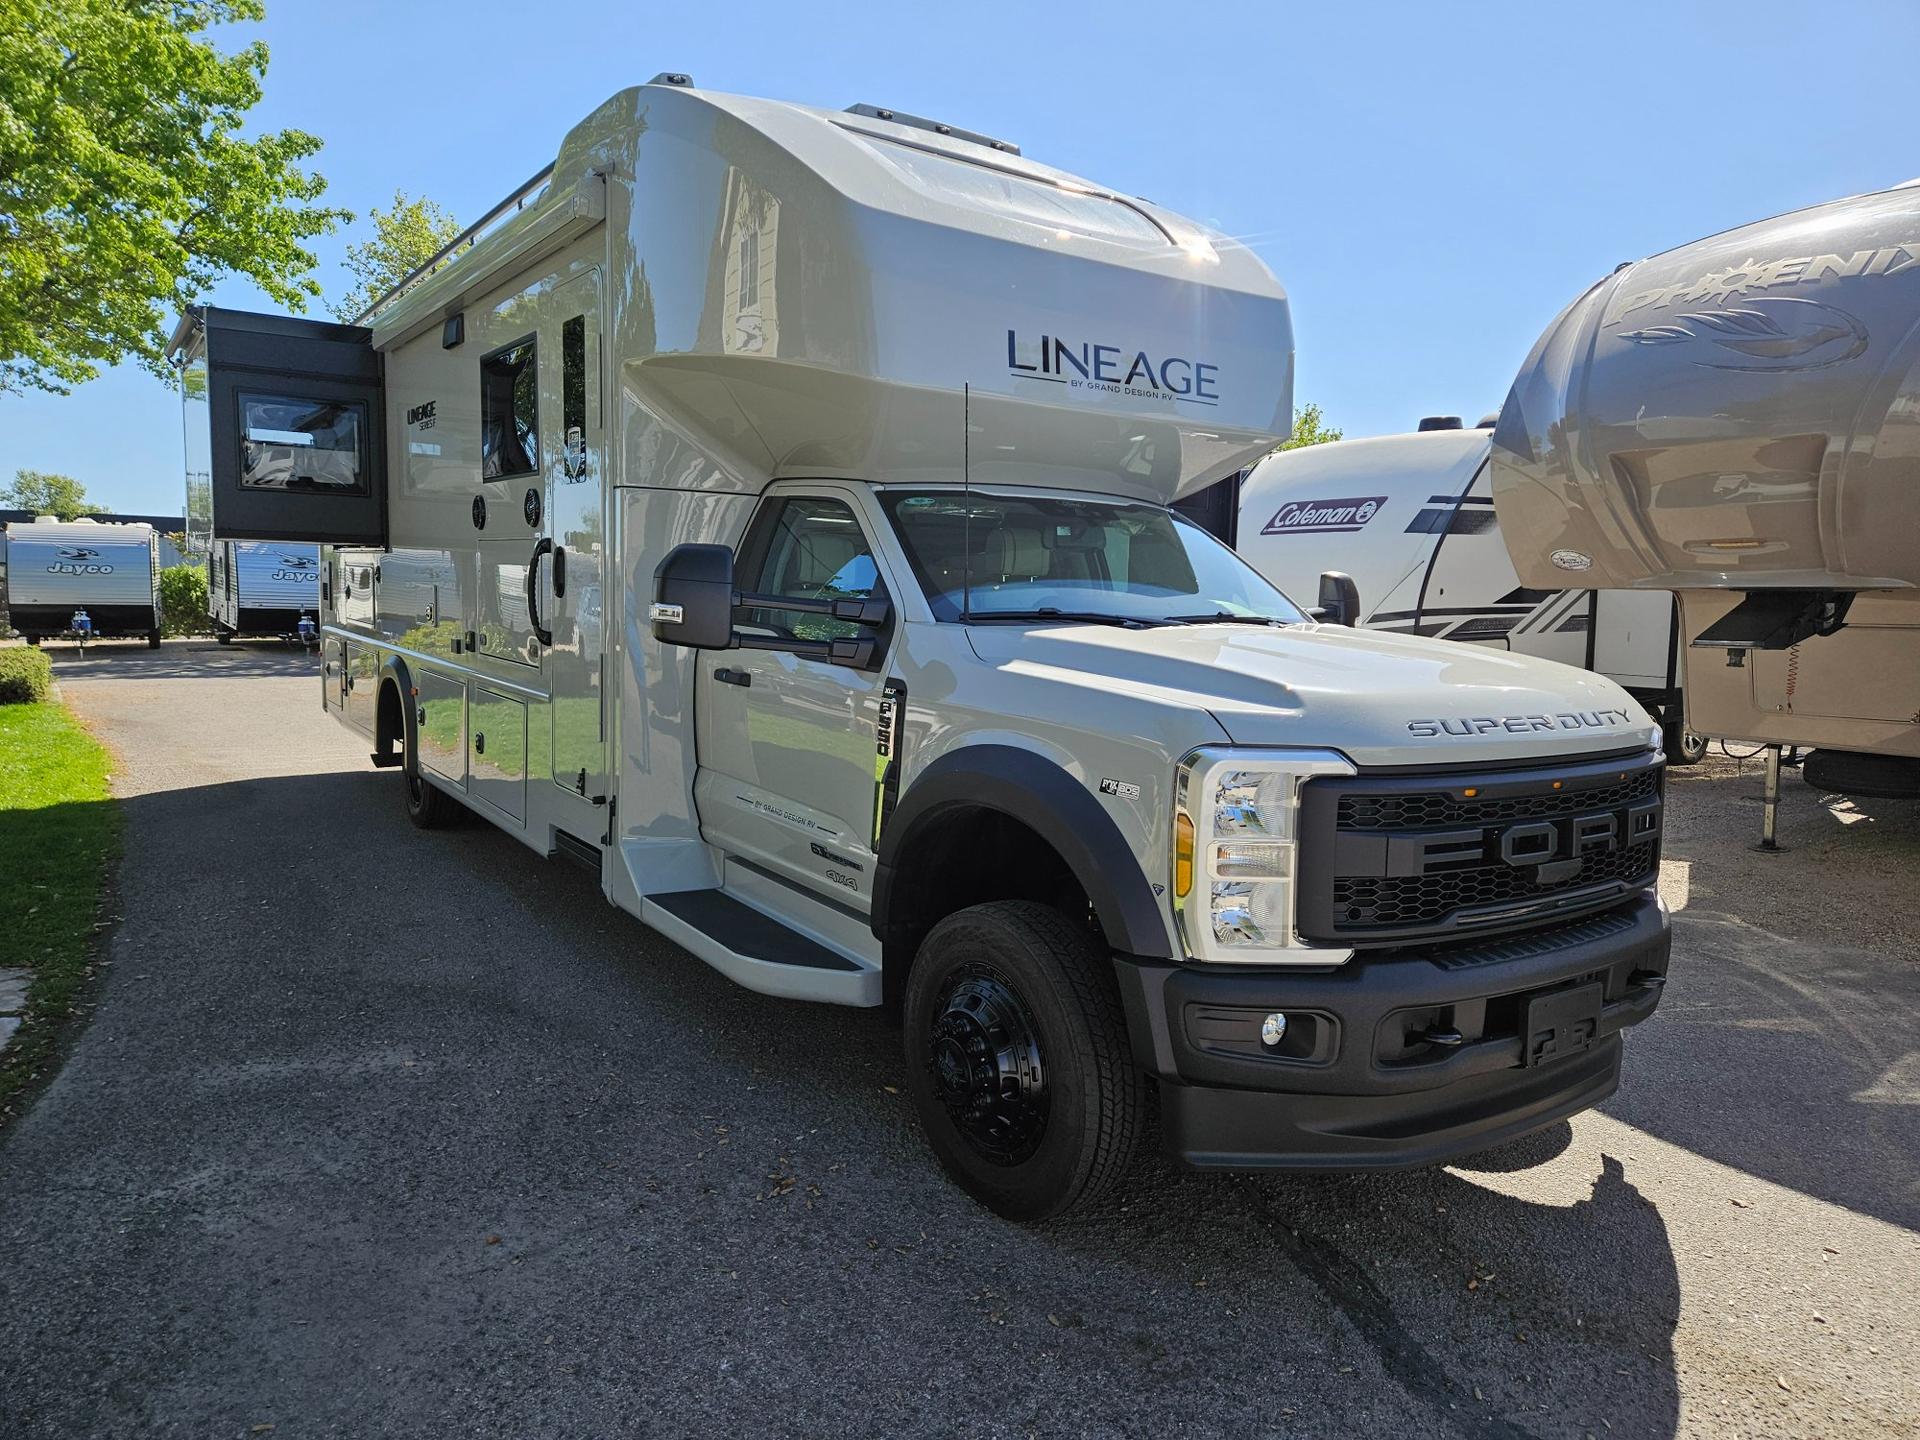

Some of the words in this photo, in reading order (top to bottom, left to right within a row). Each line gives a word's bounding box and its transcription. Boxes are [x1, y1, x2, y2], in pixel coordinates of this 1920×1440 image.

[1007, 329, 1219, 400] LINEAGE
[1071, 379, 1083, 388] BY
[1087, 382, 1121, 394] GRAND
[1124, 387, 1159, 399] DESIGN
[1162, 393, 1173, 401] RV
[407, 400, 436, 425] LINEAGE
[419, 419, 433, 431] SERIES
[1274, 502, 1357, 527] Coleman
[46, 561, 114, 576] Jayco
[271, 568, 320, 583] Jayc
[1406, 714, 1556, 738] SUPER
[1556, 708, 1633, 730] DUTY
[754, 800, 762, 809] BY
[763, 804, 783, 817] GRAND
[783, 811, 806, 826] DESIGN
[1387, 803, 1661, 878] FORD
